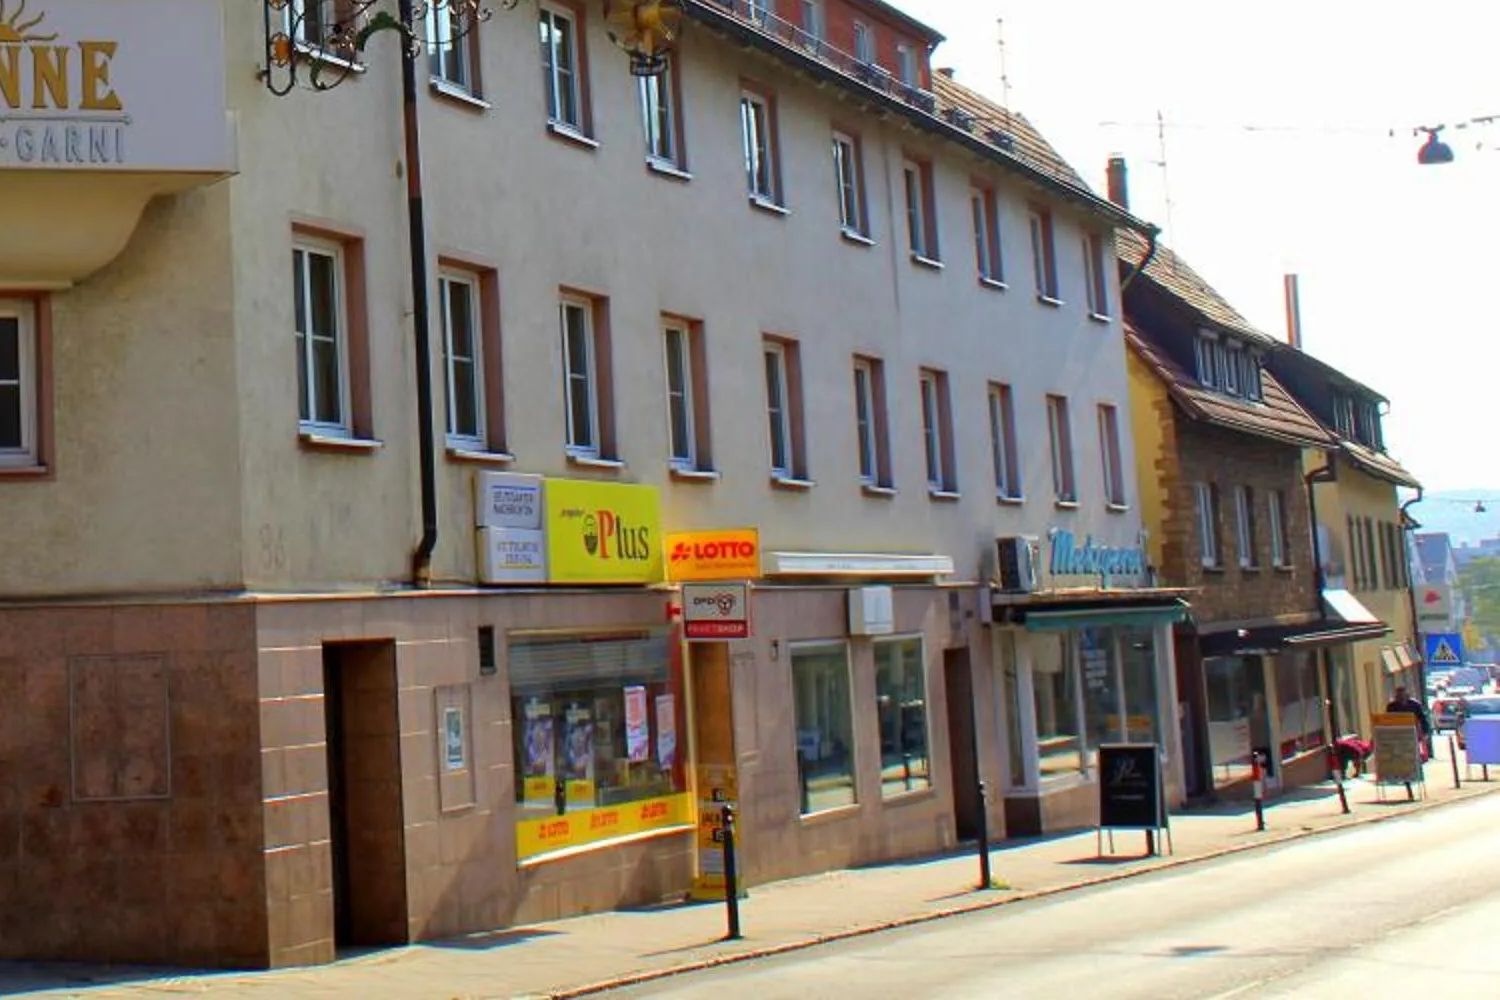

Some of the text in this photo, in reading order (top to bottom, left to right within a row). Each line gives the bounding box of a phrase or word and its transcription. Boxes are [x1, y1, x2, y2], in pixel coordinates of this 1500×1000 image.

[15, 125, 125, 163] GARNI
[596, 509, 650, 561] Plus
[694, 541, 755, 560] LOTTO
